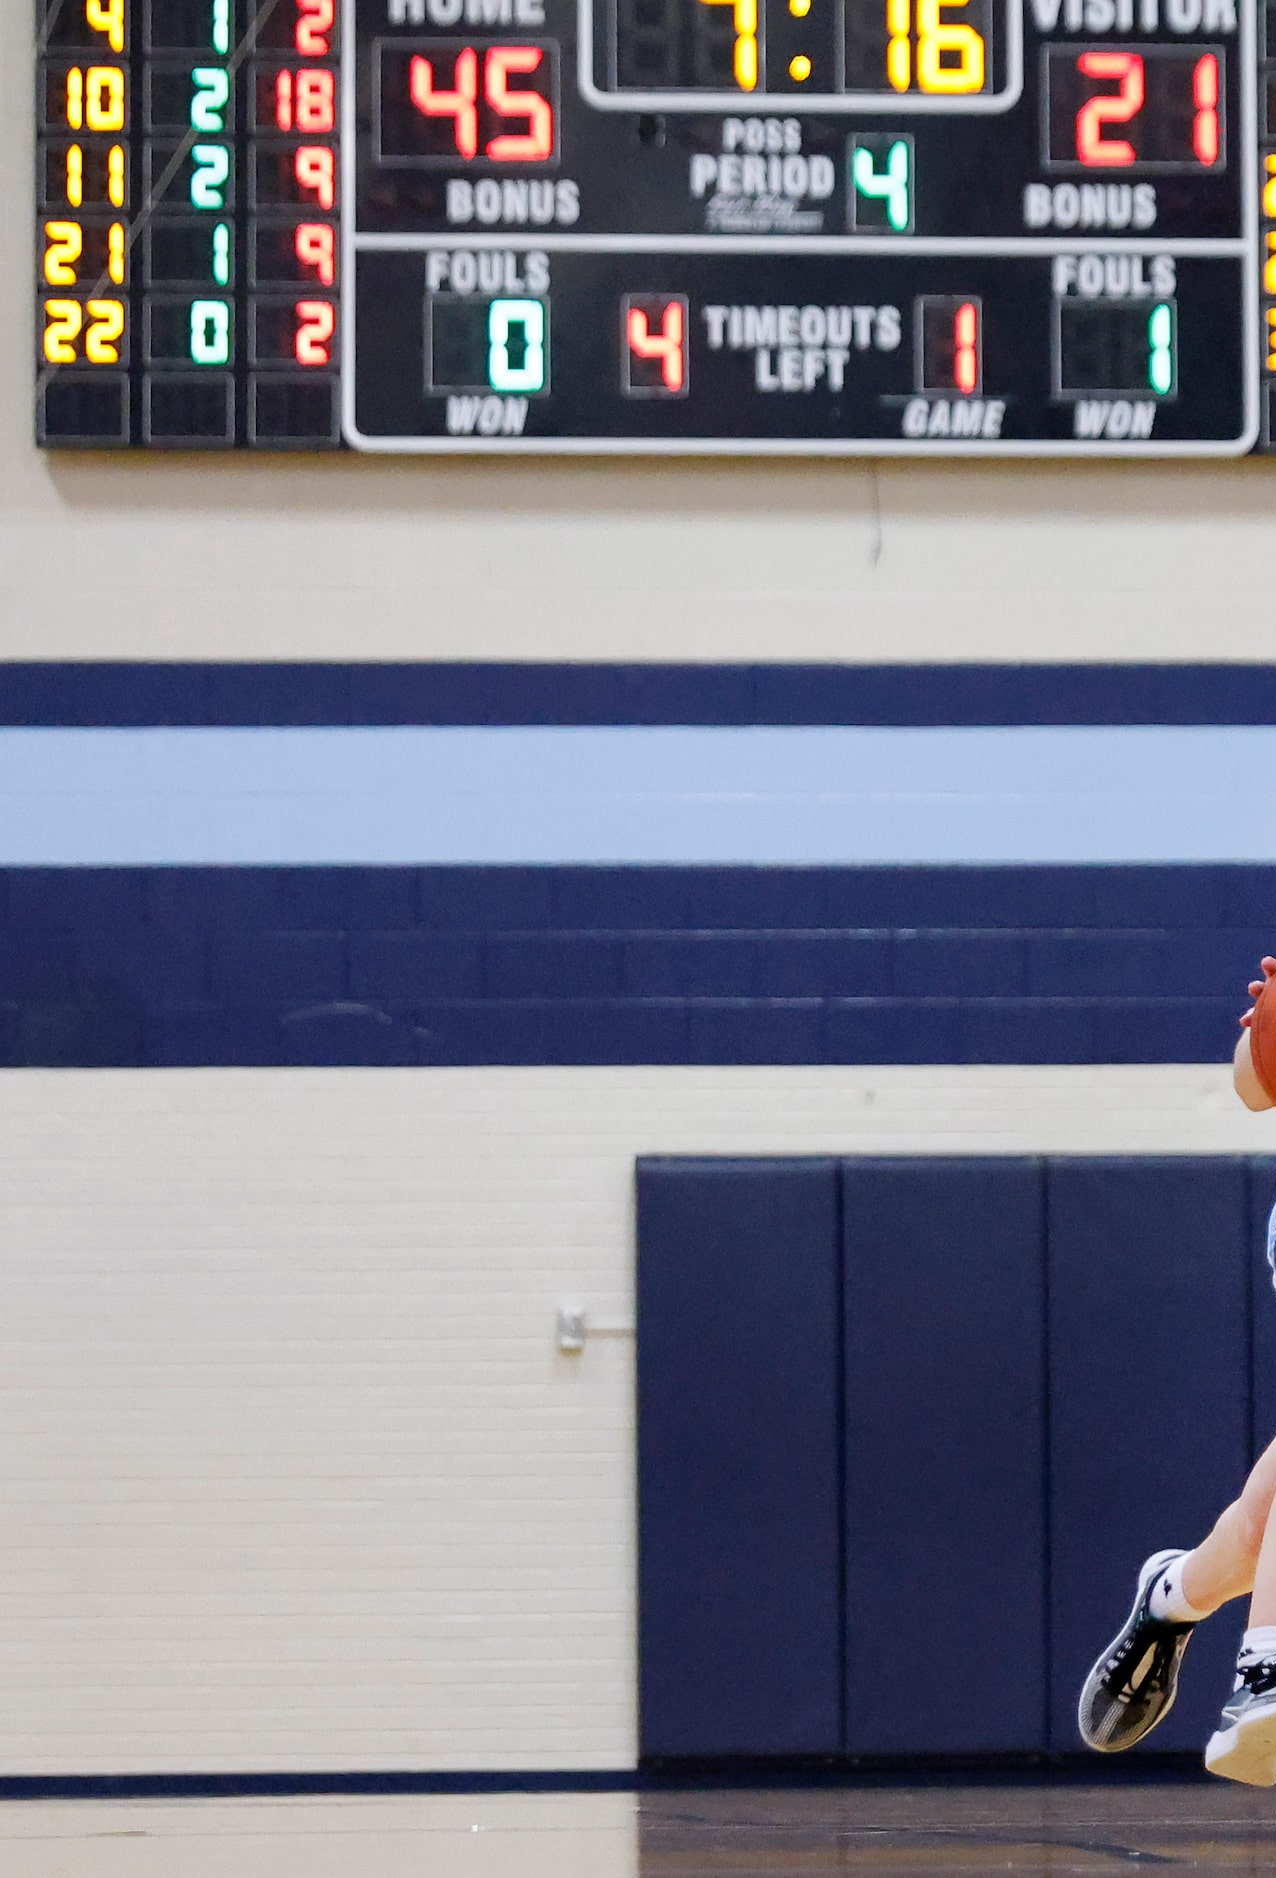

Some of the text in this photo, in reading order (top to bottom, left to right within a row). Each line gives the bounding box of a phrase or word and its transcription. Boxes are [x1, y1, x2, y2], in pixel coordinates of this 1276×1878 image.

[1033, 0, 1238, 35] VISITOR
[66, 66, 331, 133] 10 2 18
[410, 46, 553, 162] 45
[1077, 52, 1221, 167] 21
[721, 118, 802, 153] POSS
[66, 144, 331, 210] 11 2 9
[689, 154, 835, 200] PERIOD
[852, 140, 909, 231] 4
[446, 179, 580, 224] BONUS
[1023, 183, 1157, 229] BONUS
[44, 221, 331, 286] 21 1 9
[426, 251, 550, 291] FOULS
[1052, 255, 1176, 297] FOULS
[44, 299, 331, 365] 22 0 2
[488, 299, 544, 392] 0
[626, 302, 684, 392] 4
[702, 305, 901, 350] TIMEOUTS
[954, 303, 977, 394] 1
[1149, 304, 1171, 395] 1
[754, 348, 850, 392] LEFT
[446, 396, 529, 435] WON
[902, 400, 1007, 439] GAME
[1074, 400, 1157, 440] WON
